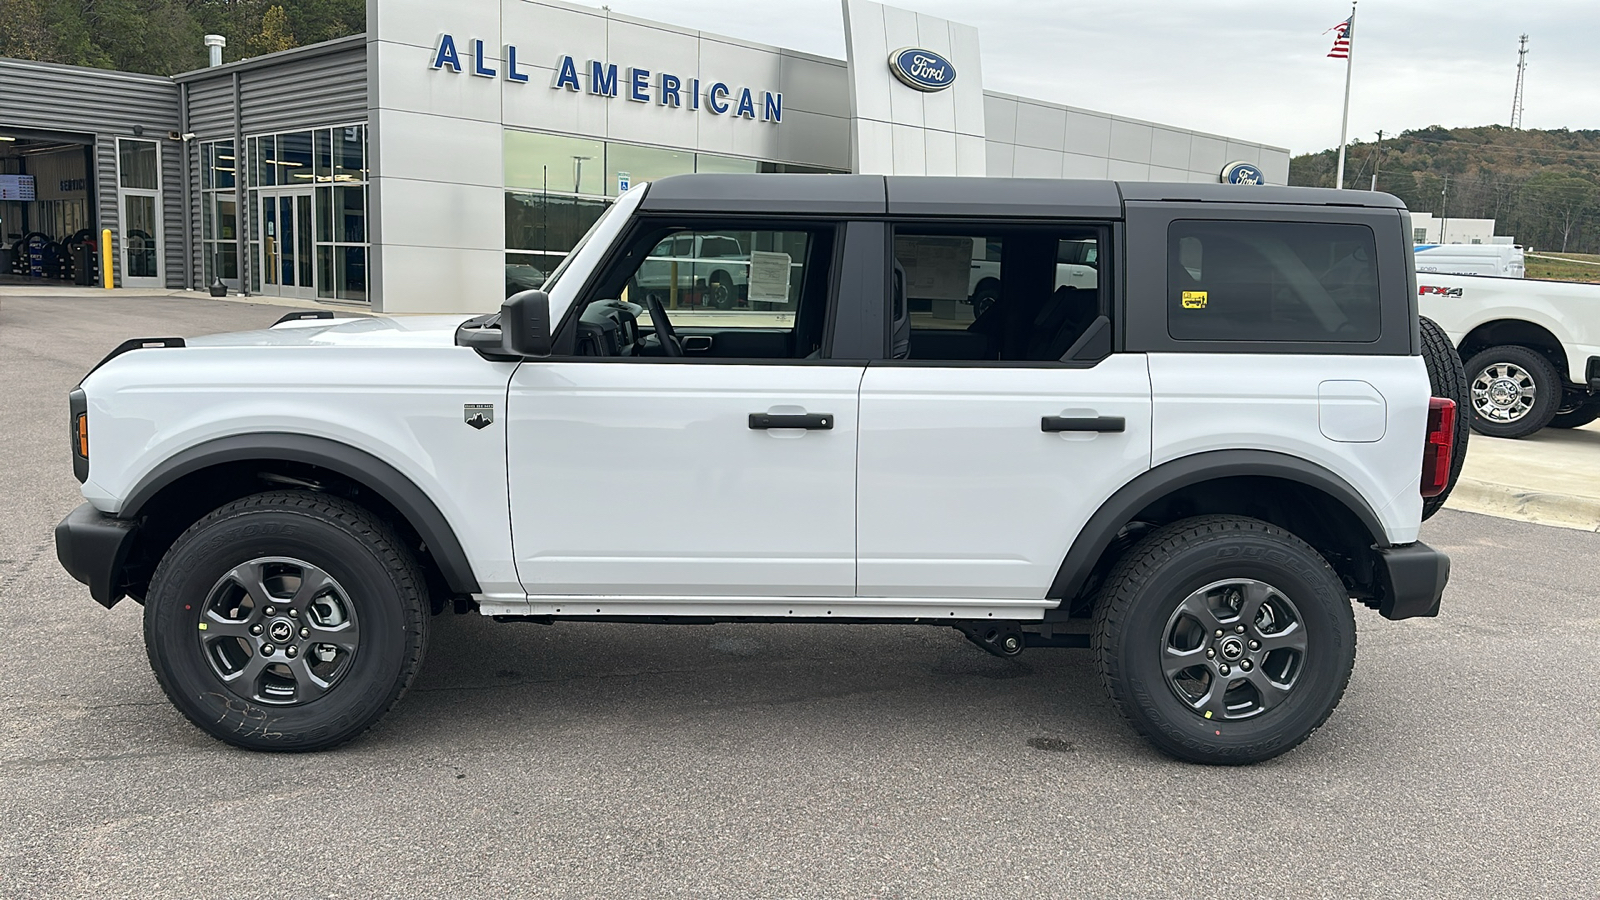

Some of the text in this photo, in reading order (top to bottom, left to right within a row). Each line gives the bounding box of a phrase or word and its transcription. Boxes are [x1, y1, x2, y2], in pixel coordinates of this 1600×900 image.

[431, 33, 783, 123] ALL AMERICAN
[911, 55, 945, 81] Ford
[1418, 286, 1463, 296] FX4
[1215, 545, 1333, 605] DUELER
